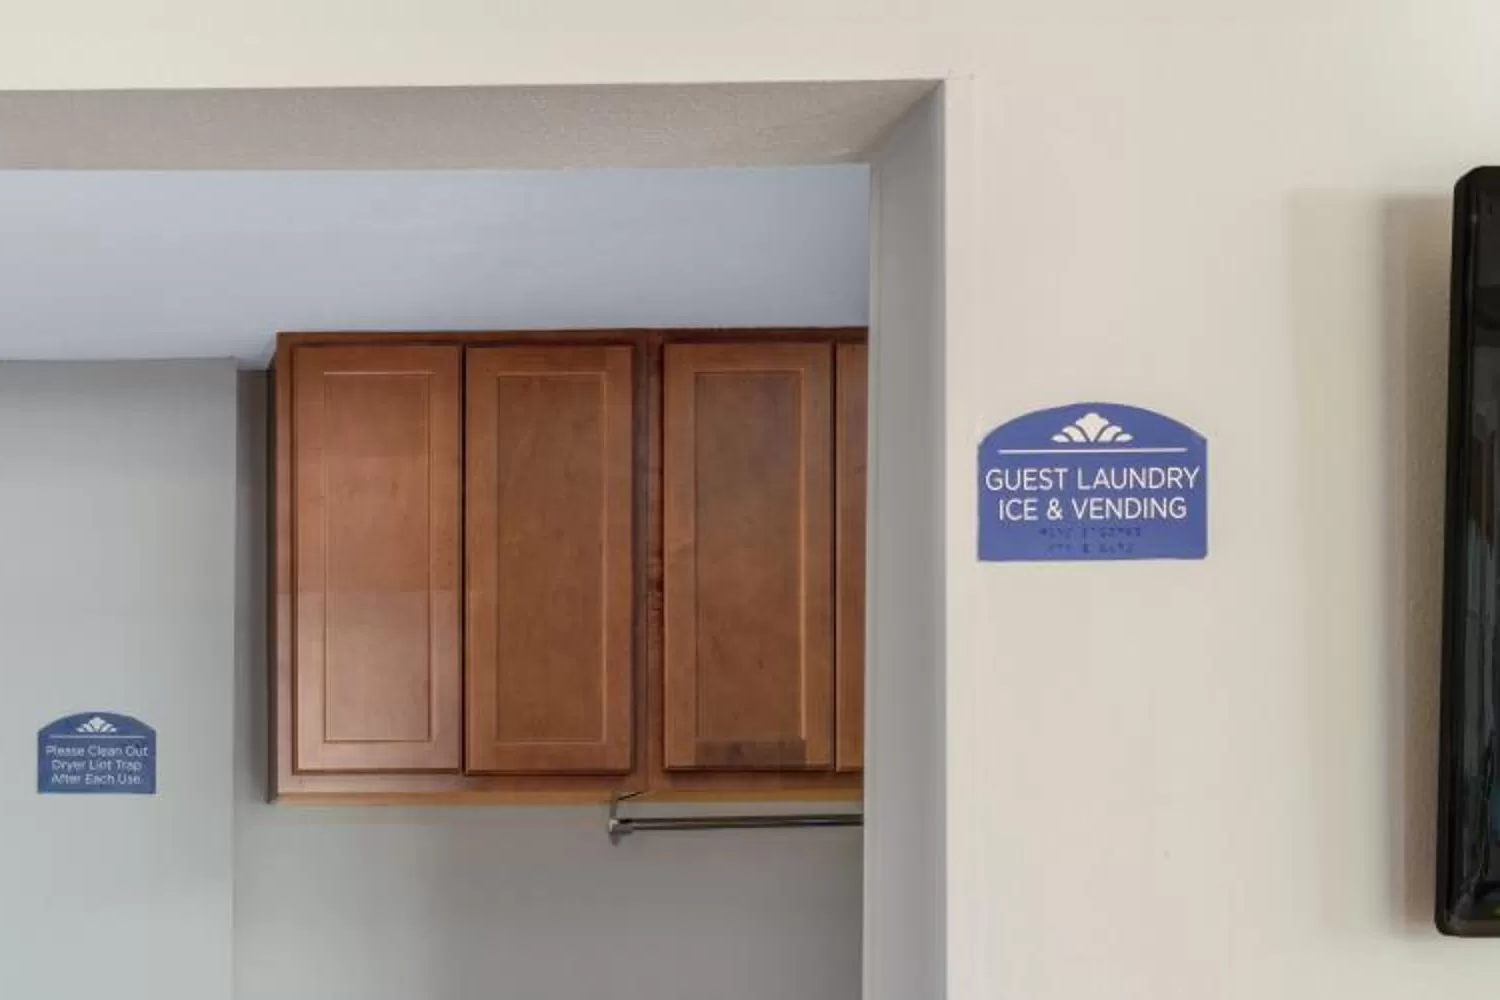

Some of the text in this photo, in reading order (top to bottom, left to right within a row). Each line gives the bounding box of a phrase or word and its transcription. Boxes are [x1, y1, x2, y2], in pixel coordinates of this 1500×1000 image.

[985, 466, 1200, 491] GUEST LAUNDRY
[998, 497, 1188, 521] ICE & VENDING
[45, 745, 149, 757] Please Clean Out
[115, 760, 142, 773] Trap
[51, 773, 82, 785] After
[85, 773, 115, 785] Each
